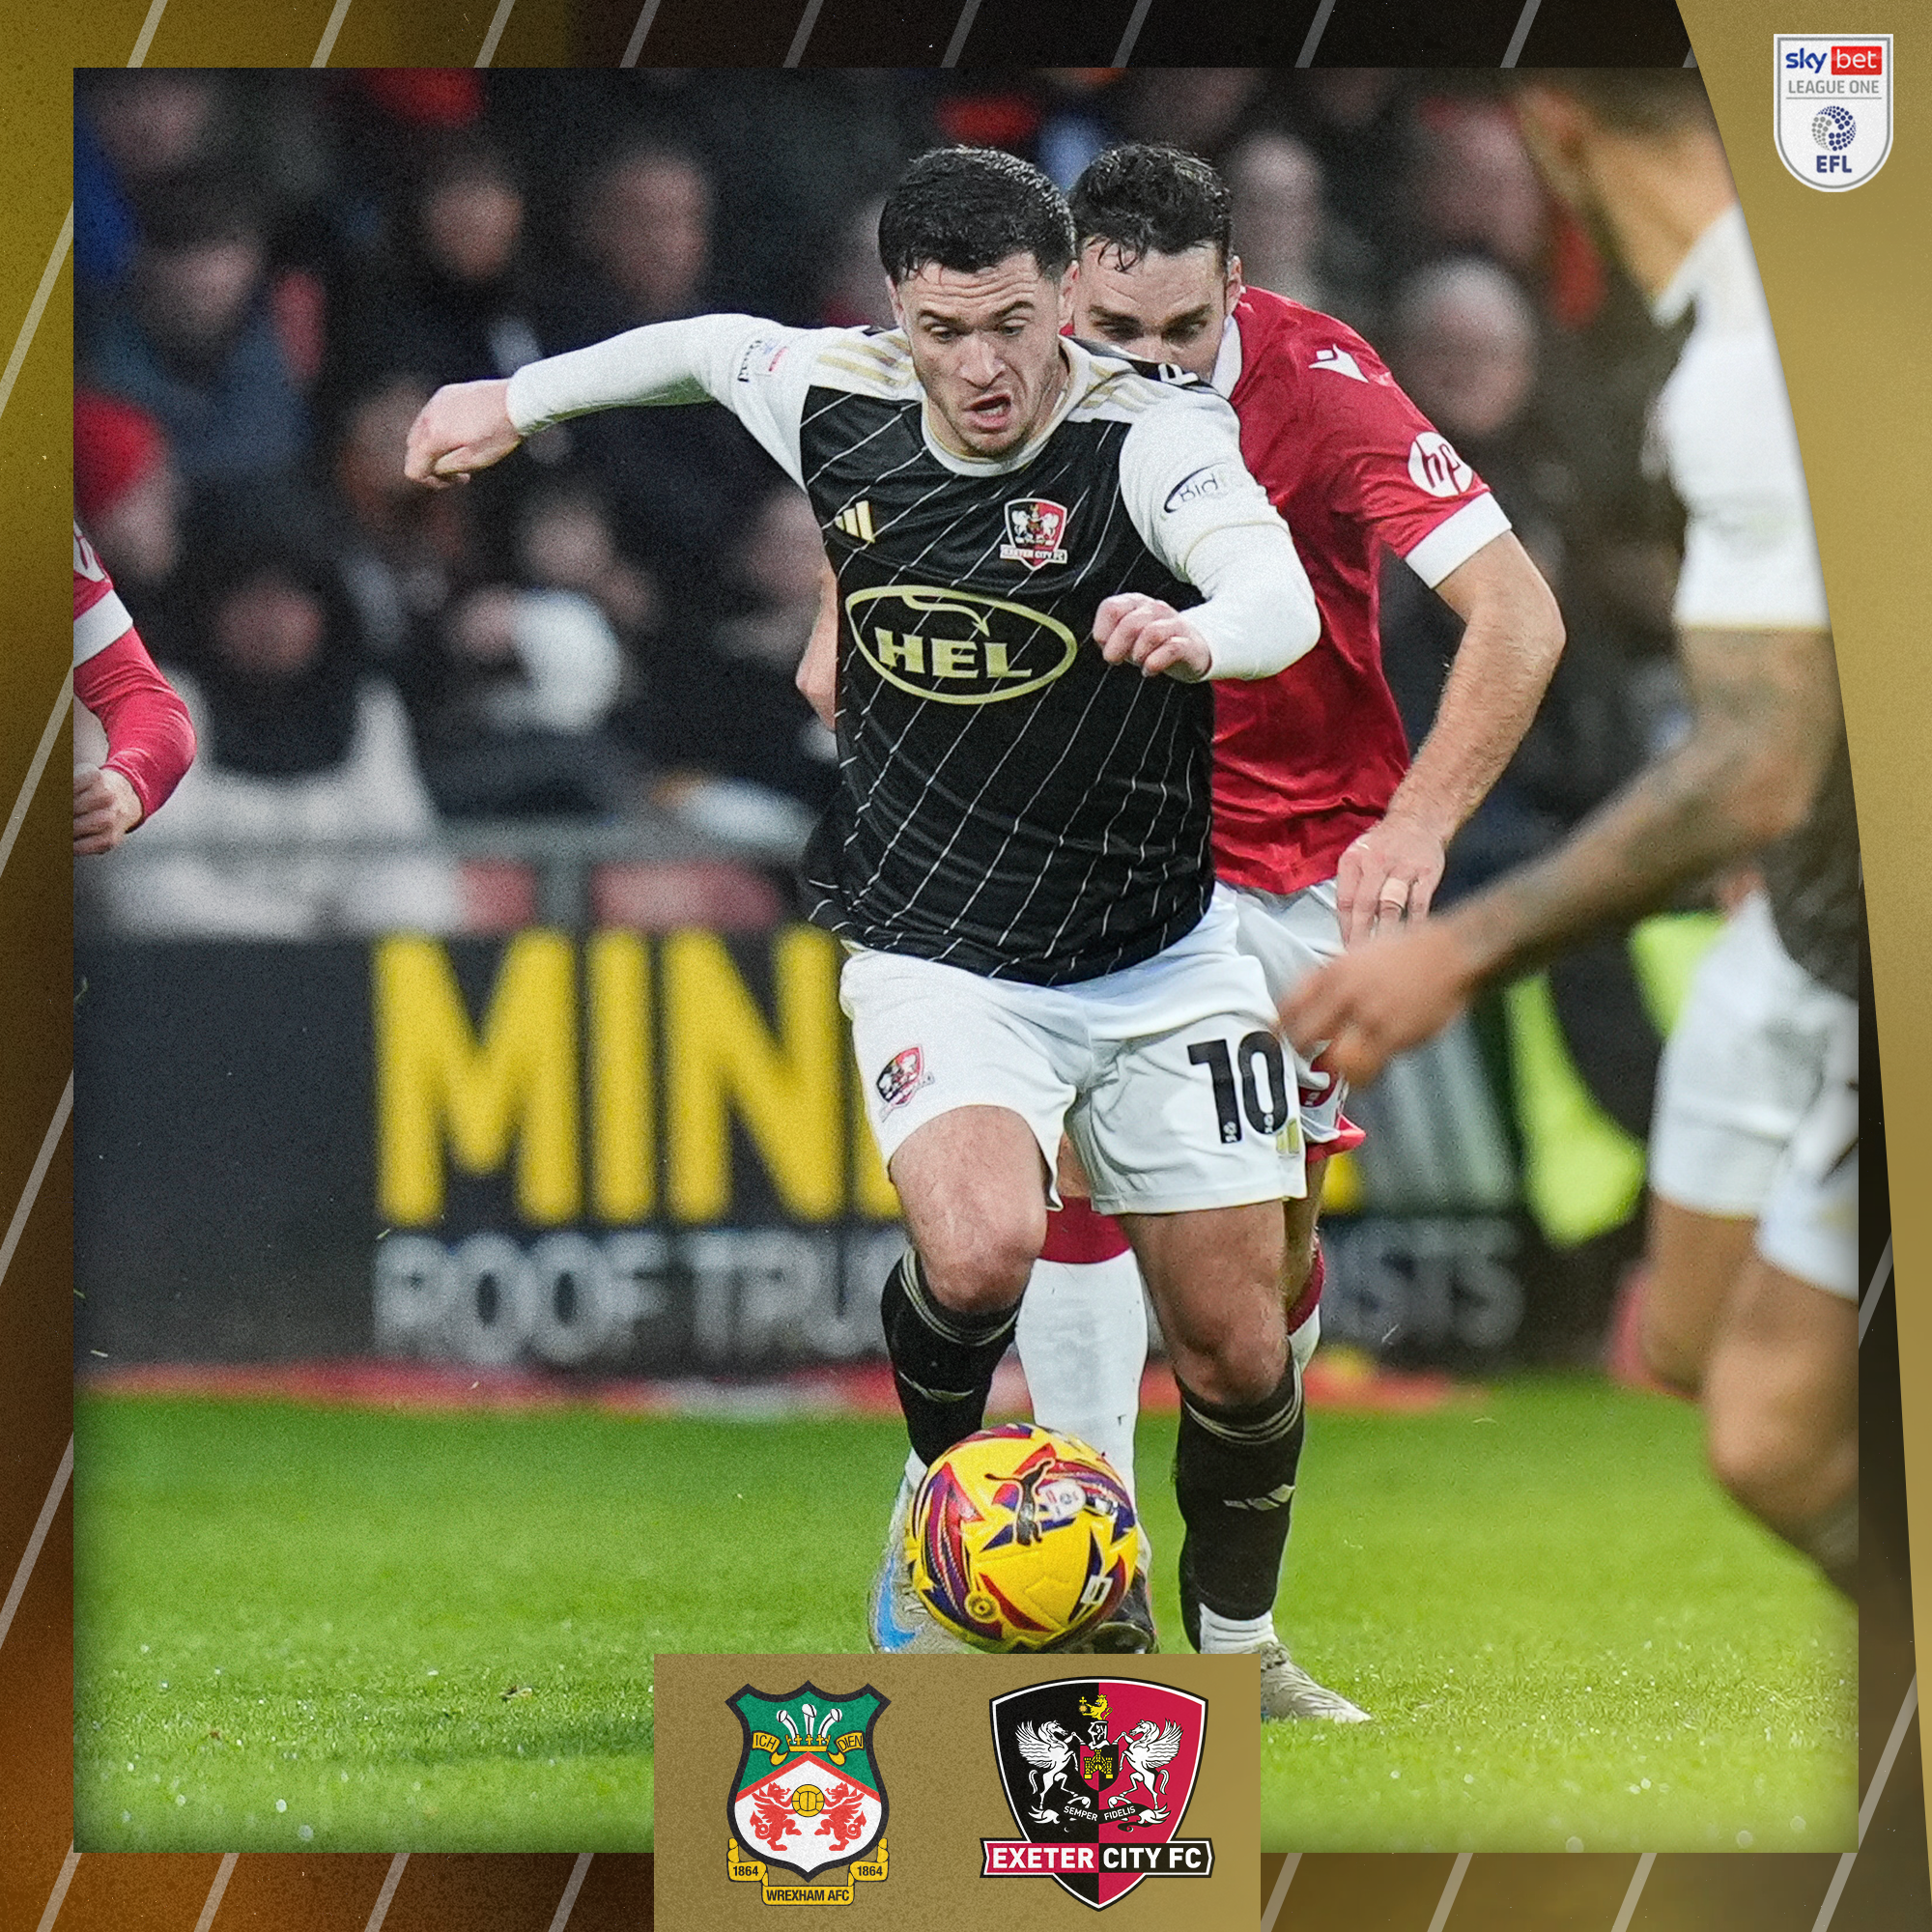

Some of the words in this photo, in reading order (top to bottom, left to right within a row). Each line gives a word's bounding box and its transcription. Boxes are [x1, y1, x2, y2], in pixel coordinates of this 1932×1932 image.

[1414, 437, 1463, 495] hp
[873, 626, 1033, 679] HEL
[1186, 1030, 1289, 1144] 10
[374, 1231, 671, 1362] ROOF
[678, 1231, 900, 1357] TRU
